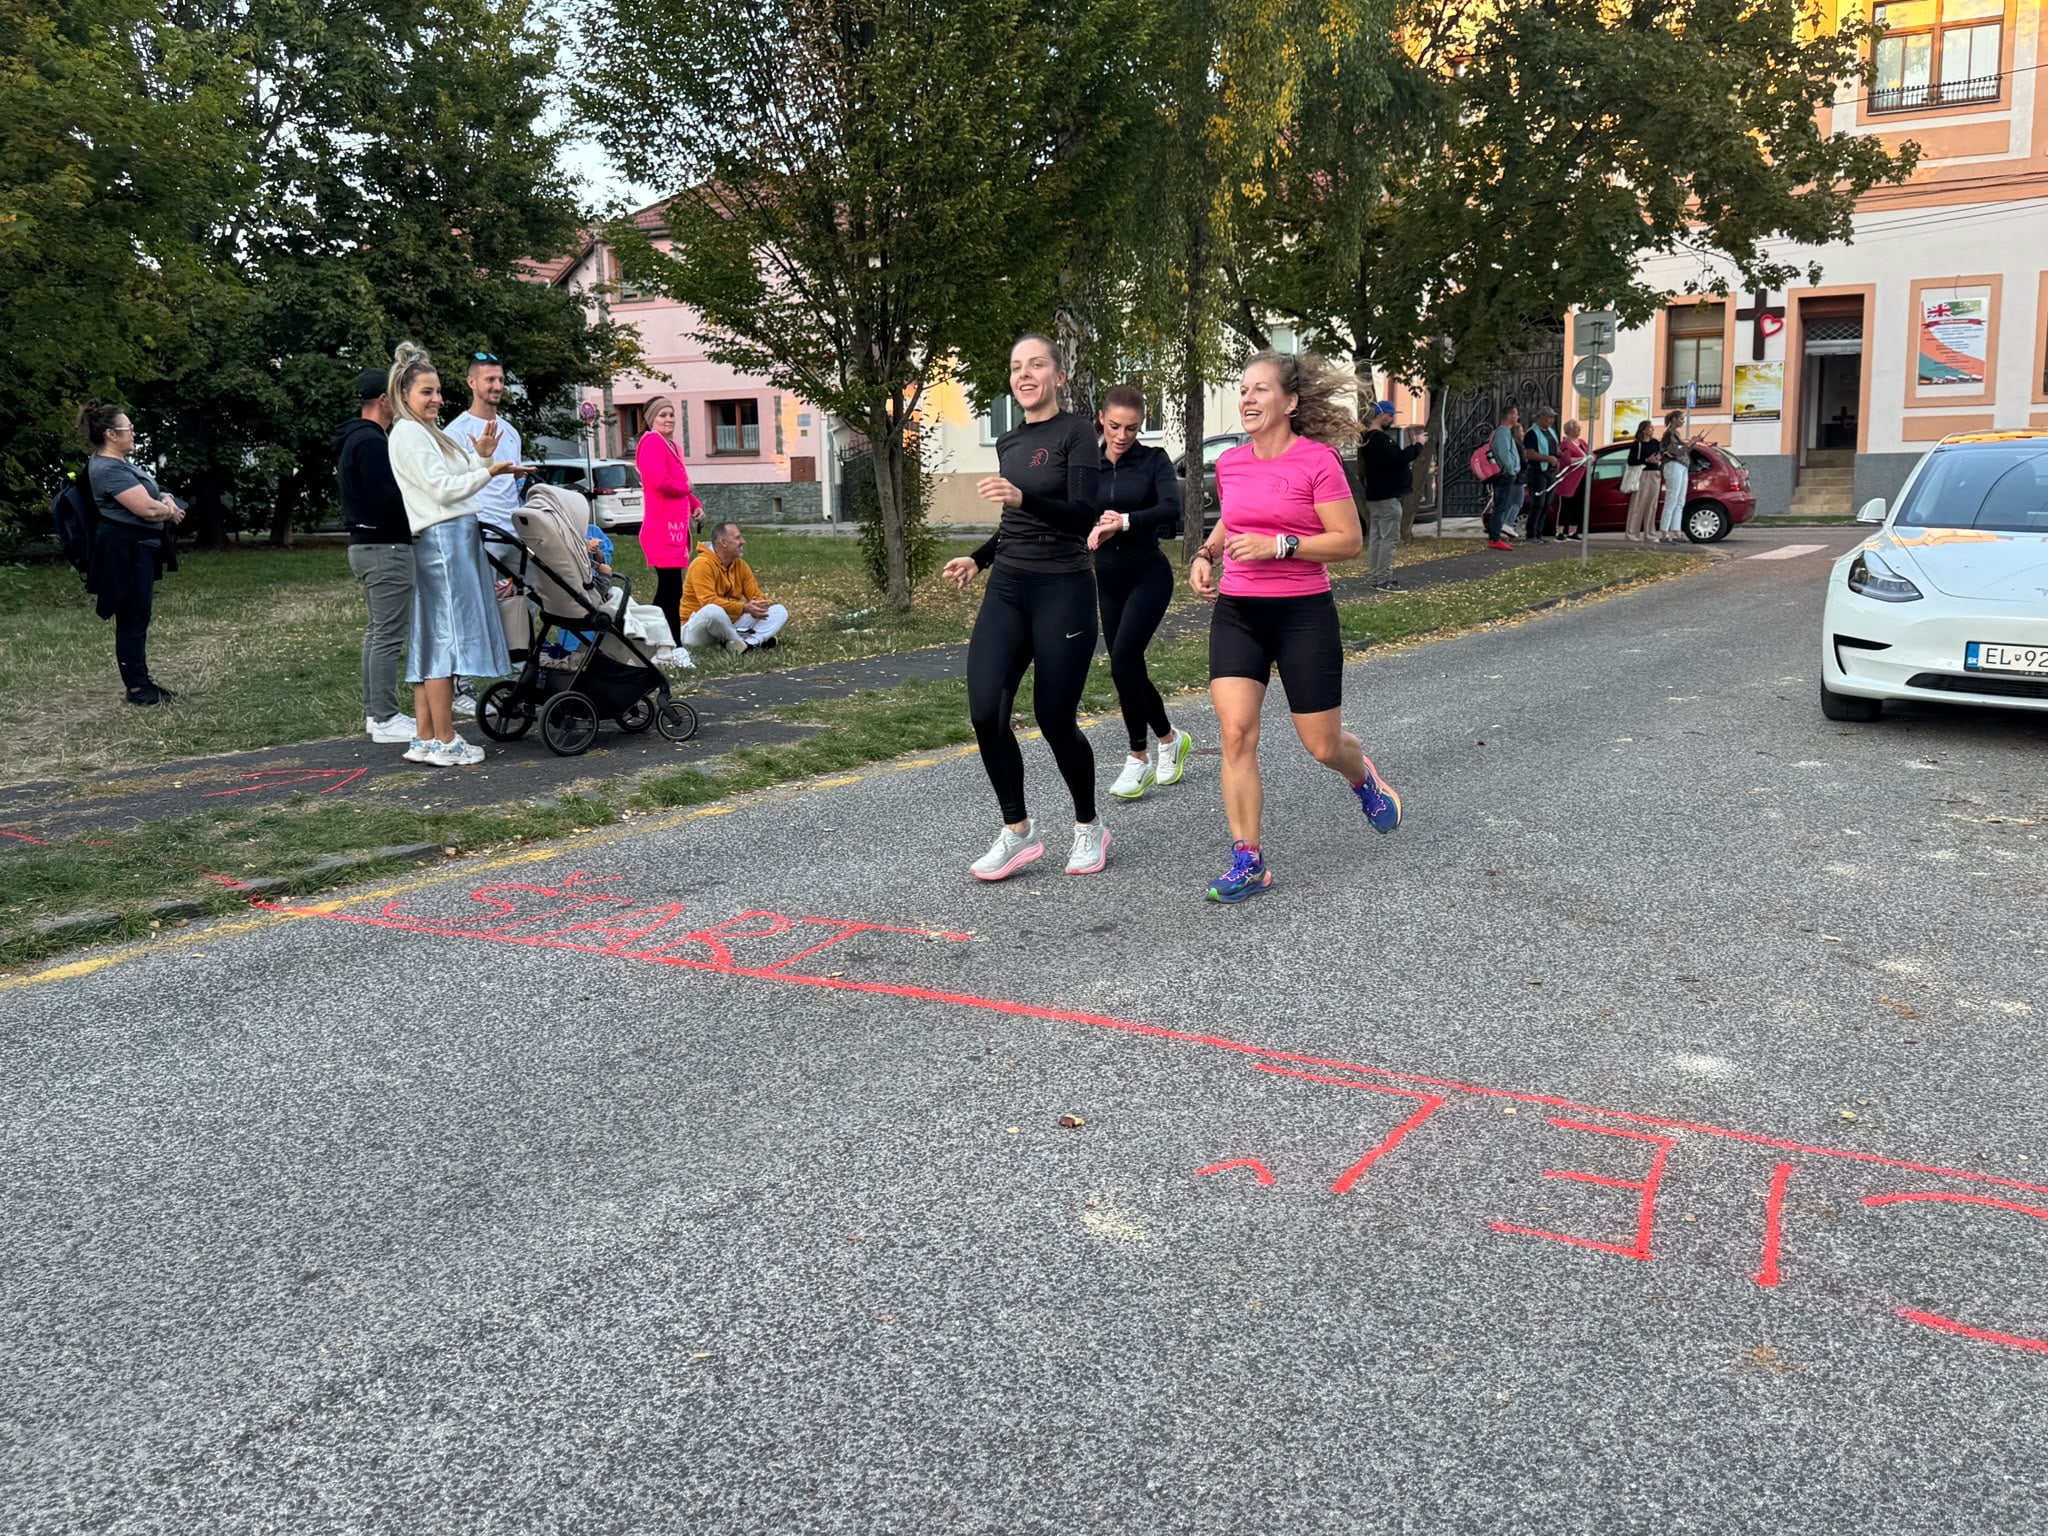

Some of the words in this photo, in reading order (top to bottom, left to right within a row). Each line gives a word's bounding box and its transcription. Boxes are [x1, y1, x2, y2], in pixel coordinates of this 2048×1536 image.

[667, 521, 685, 530] MA
[669, 532, 684, 542] YO
[1986, 648, 2012, 665] EL
